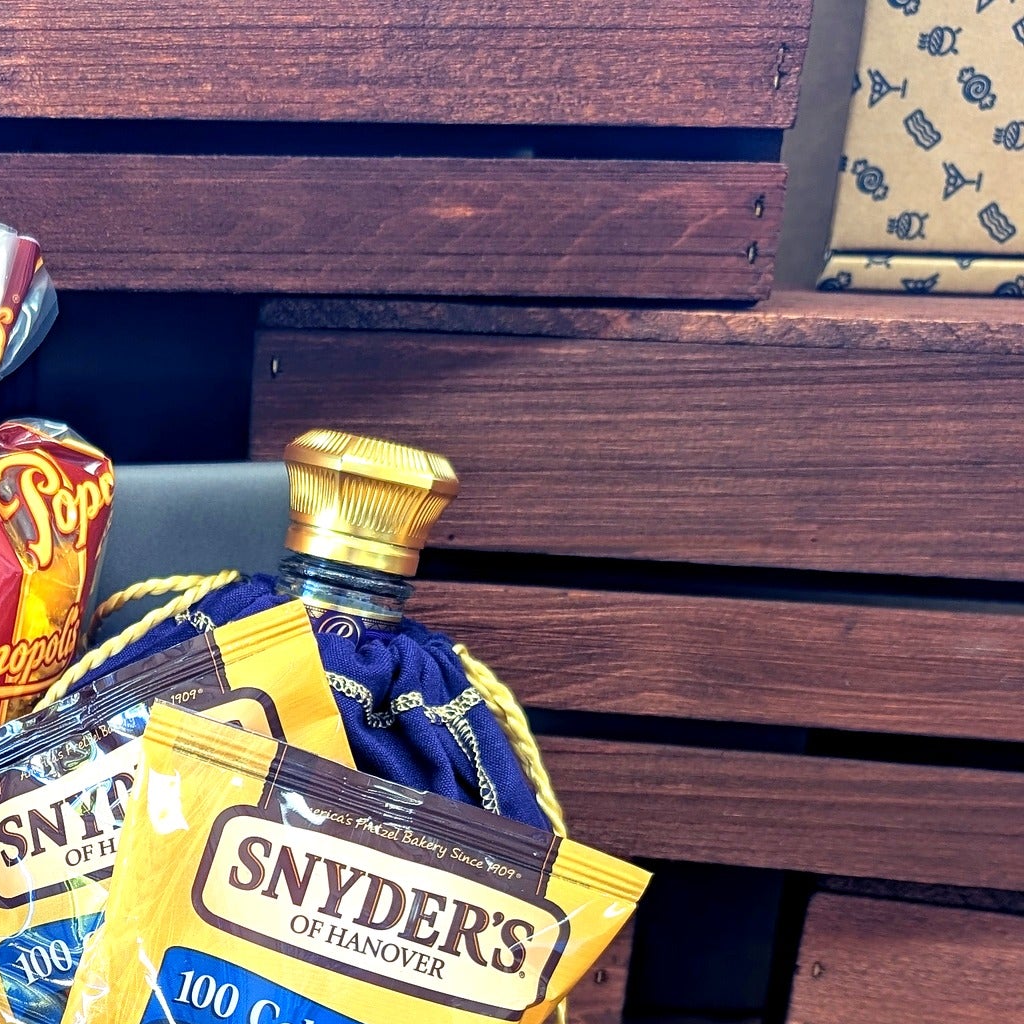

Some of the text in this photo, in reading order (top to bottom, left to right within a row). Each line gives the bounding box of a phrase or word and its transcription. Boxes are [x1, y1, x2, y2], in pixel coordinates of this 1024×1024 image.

[64, 843, 94, 868] OF
[400, 830, 447, 859] Bakery
[450, 846, 484, 870] Since
[486, 860, 517, 881] 1909
[228, 835, 535, 974] SNYDER'S
[14, 939, 74, 987] 100
[289, 914, 447, 980] OF HANOVER
[173, 969, 240, 1019] 100
